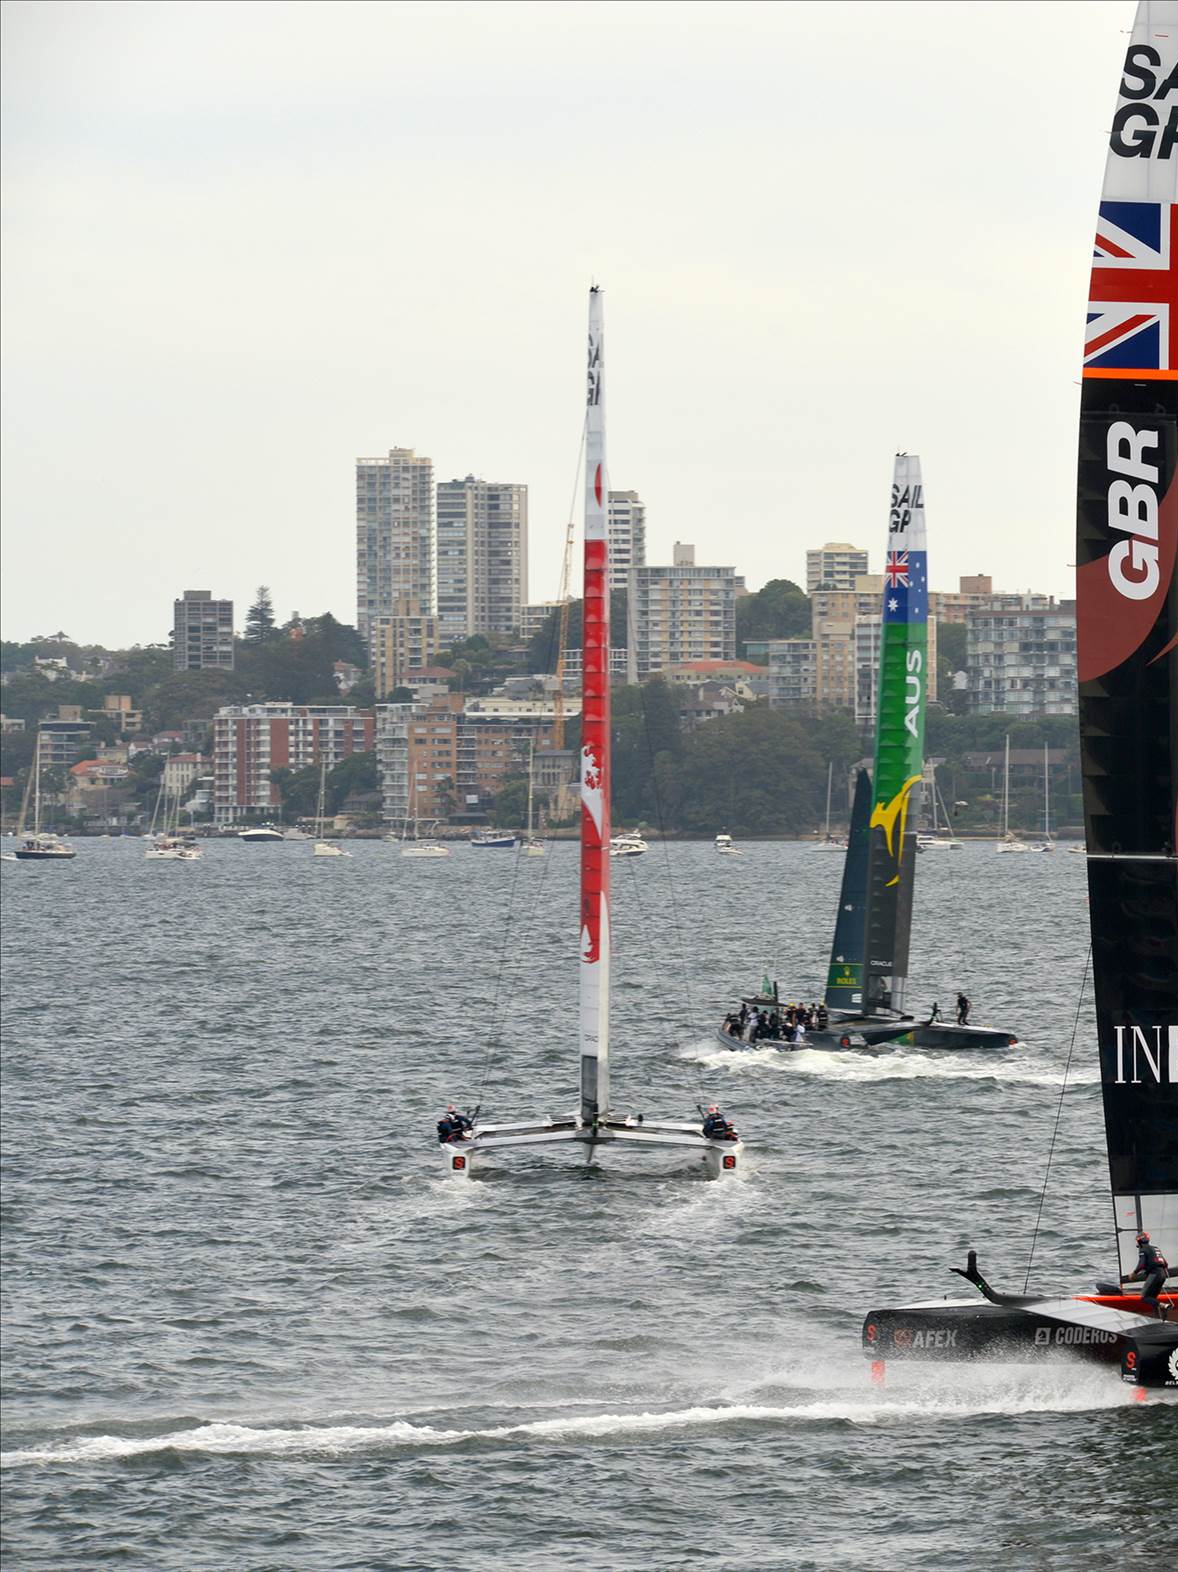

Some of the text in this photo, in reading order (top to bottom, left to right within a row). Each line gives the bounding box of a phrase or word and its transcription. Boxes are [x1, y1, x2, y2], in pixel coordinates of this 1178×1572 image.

[891, 484, 924, 509] SAIL
[889, 509, 912, 533] GP
[1107, 421, 1160, 600] GBR
[904, 649, 922, 738] AUS
[912, 1327, 958, 1349] AFEX
